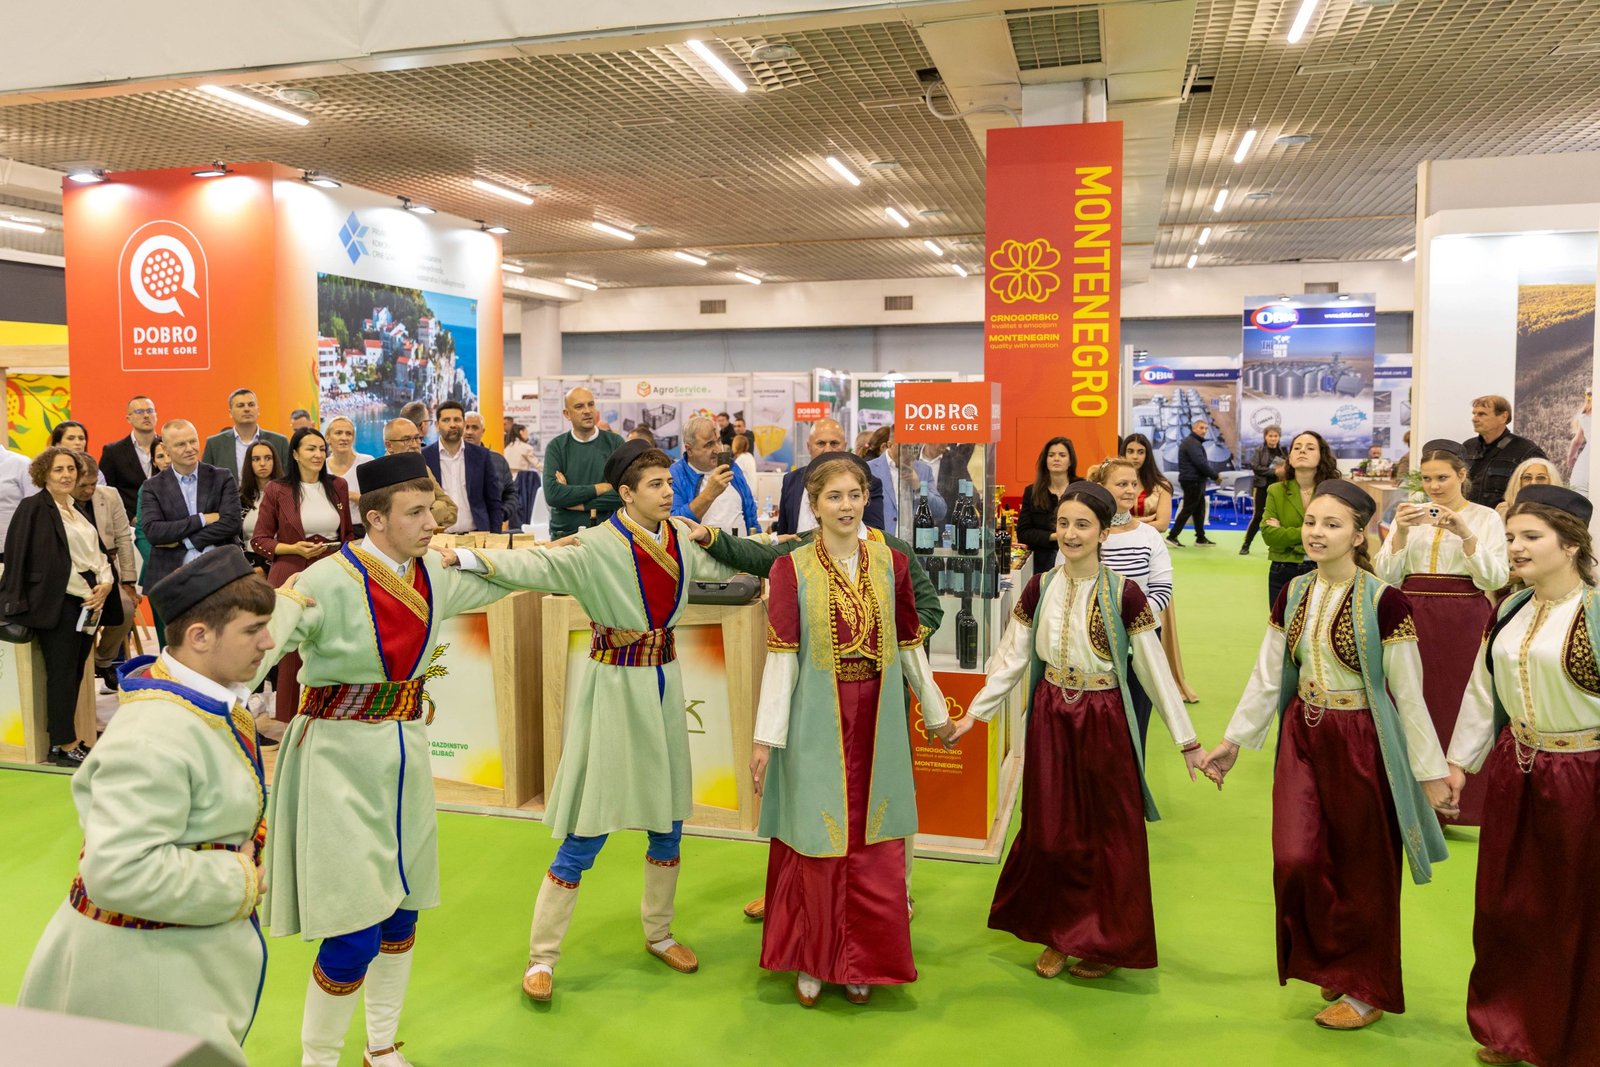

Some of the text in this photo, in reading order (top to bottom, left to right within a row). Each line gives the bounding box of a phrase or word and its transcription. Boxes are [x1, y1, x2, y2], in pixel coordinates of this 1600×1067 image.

[1071, 166, 1112, 417] MONTENEGRO
[990, 313, 1060, 322] CRNOGORSKO
[133, 325, 198, 344] DOBRO
[989, 333, 1060, 342] MONTENEGRIN
[133, 346, 198, 355] IZ CRNE GORE
[905, 423, 979, 431] IZ CRNE GORE
[432, 741, 469, 750] GAZDINSTVO
[914, 760, 963, 769] MONTENEGRIN
